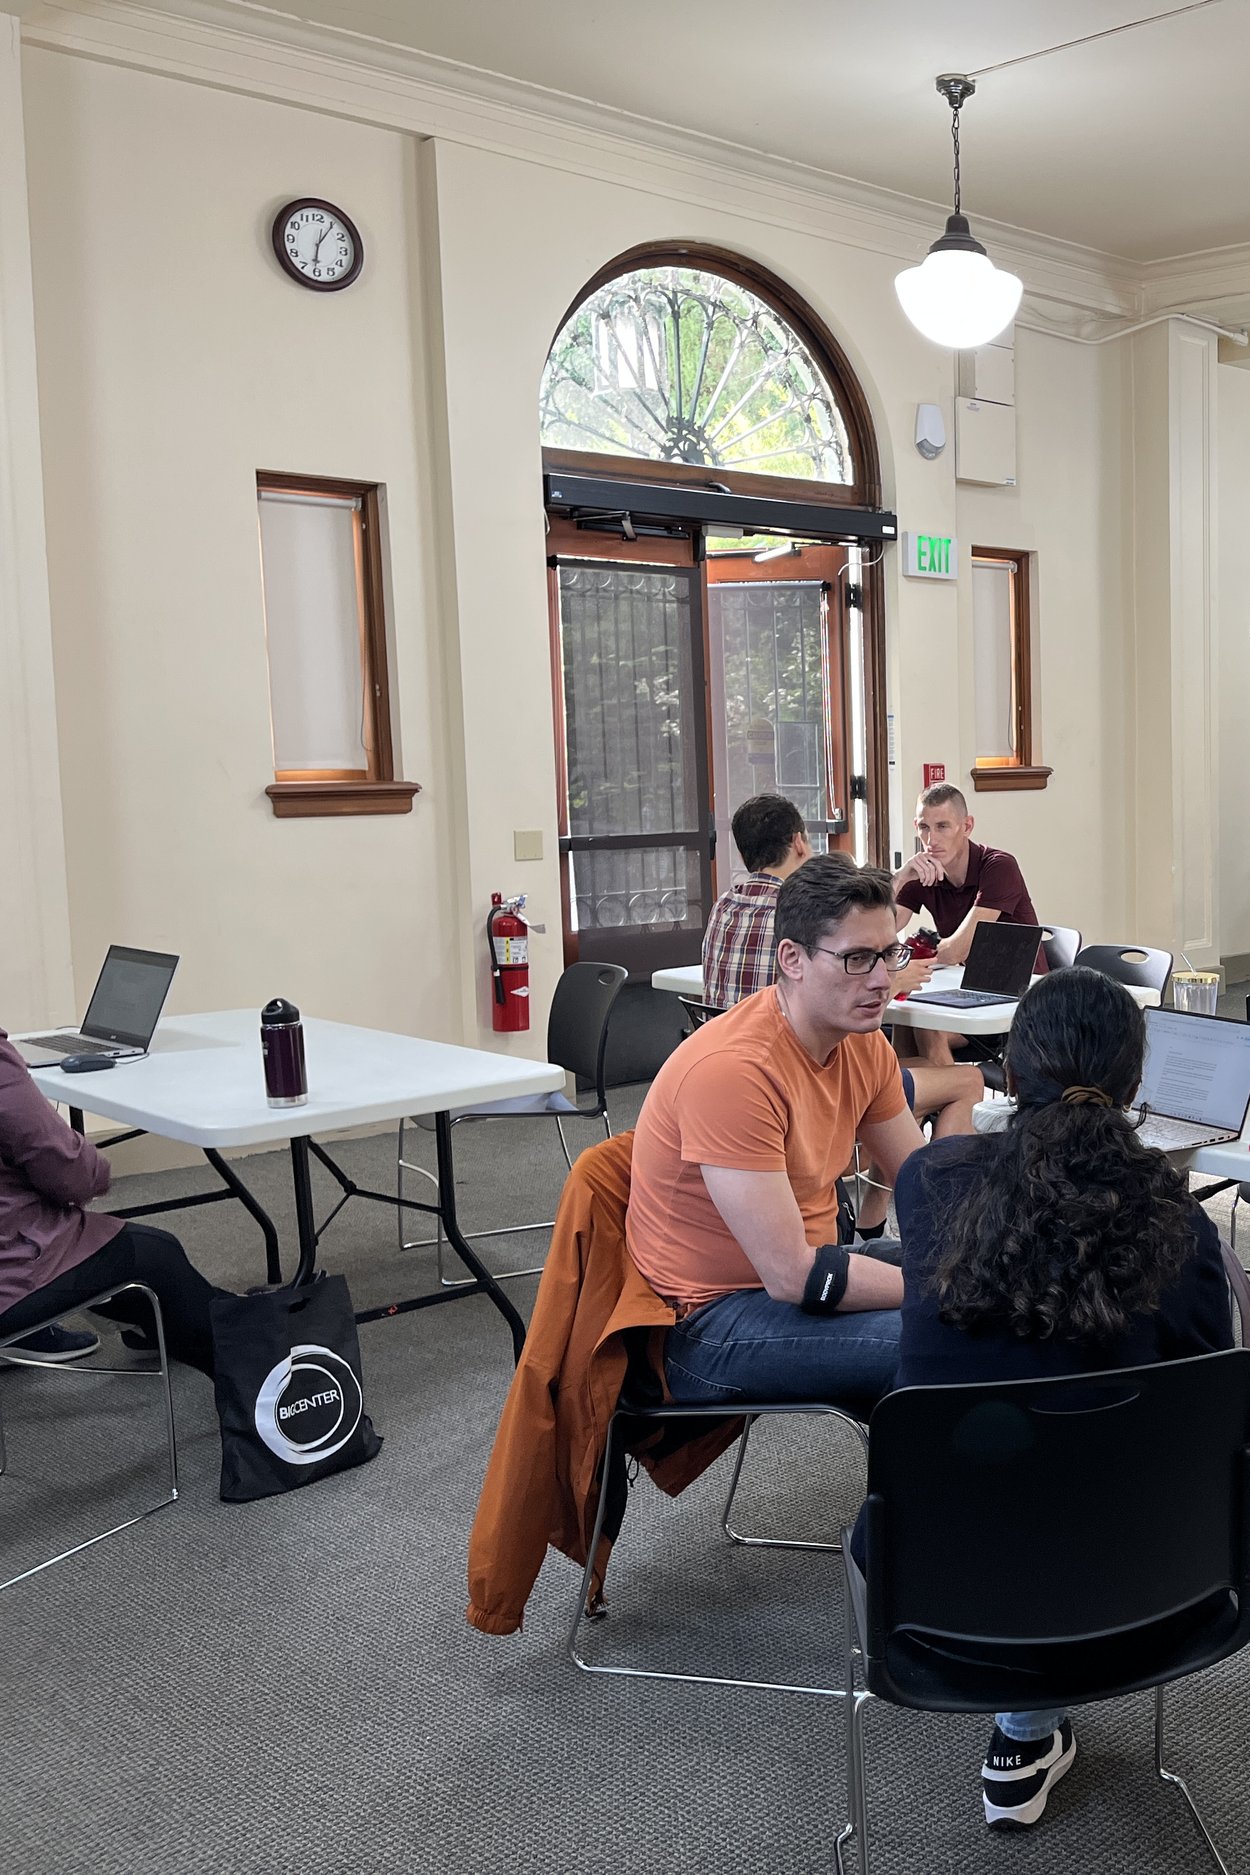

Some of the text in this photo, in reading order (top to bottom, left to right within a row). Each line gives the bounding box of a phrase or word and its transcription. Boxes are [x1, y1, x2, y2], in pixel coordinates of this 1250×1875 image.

[300, 213, 309, 222] 11
[312, 213, 325, 223] 12
[290, 221, 300, 230] 10
[286, 234, 295, 243] 9
[336, 233, 346, 242] 2
[290, 248, 299, 257] 8
[339, 247, 348, 256] 3
[299, 261, 308, 269] 7
[335, 259, 344, 267] 4
[312, 267, 321, 277] 6
[326, 267, 336, 276] 5
[917, 535, 952, 574] EXIT
[930, 767, 945, 780] FIRE
[993, 1754, 1021, 1767] NIKE
